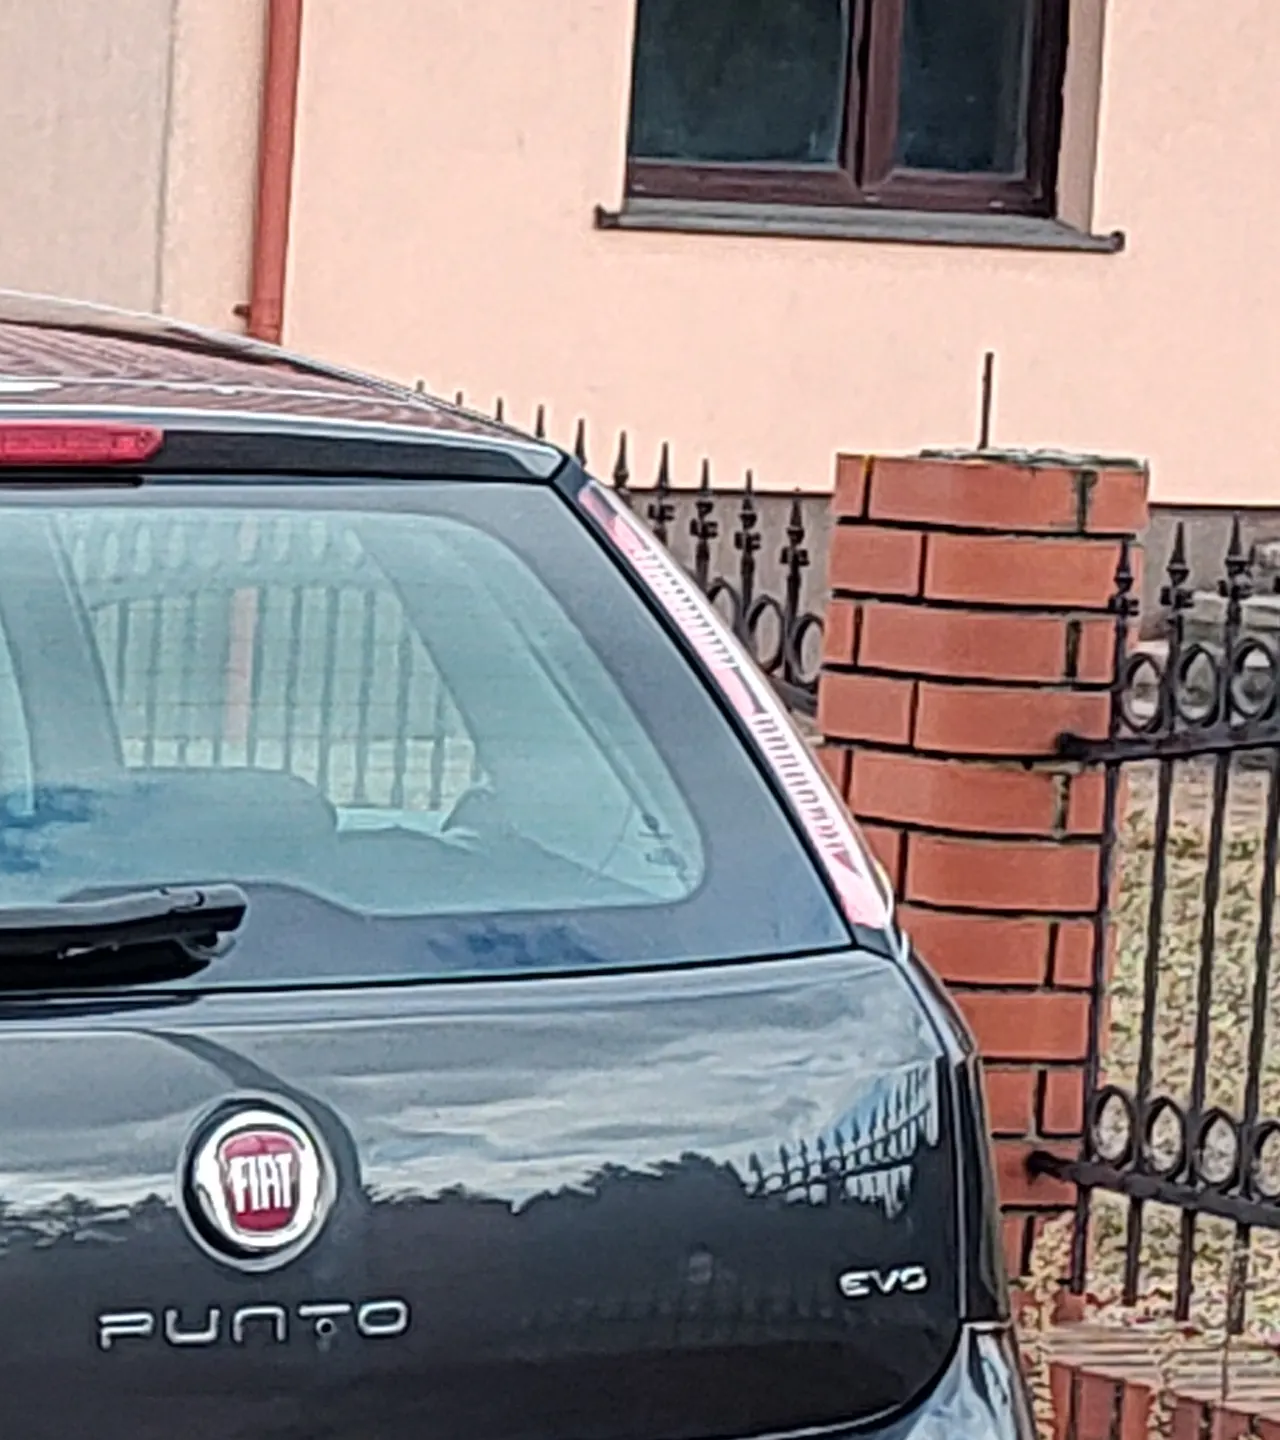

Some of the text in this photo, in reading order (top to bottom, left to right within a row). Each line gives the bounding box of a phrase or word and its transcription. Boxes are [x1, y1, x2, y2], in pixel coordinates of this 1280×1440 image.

[229, 1152, 293, 1213] FIAT
[839, 1266, 928, 1297] EVO
[98, 1300, 408, 1350] PUNTO
